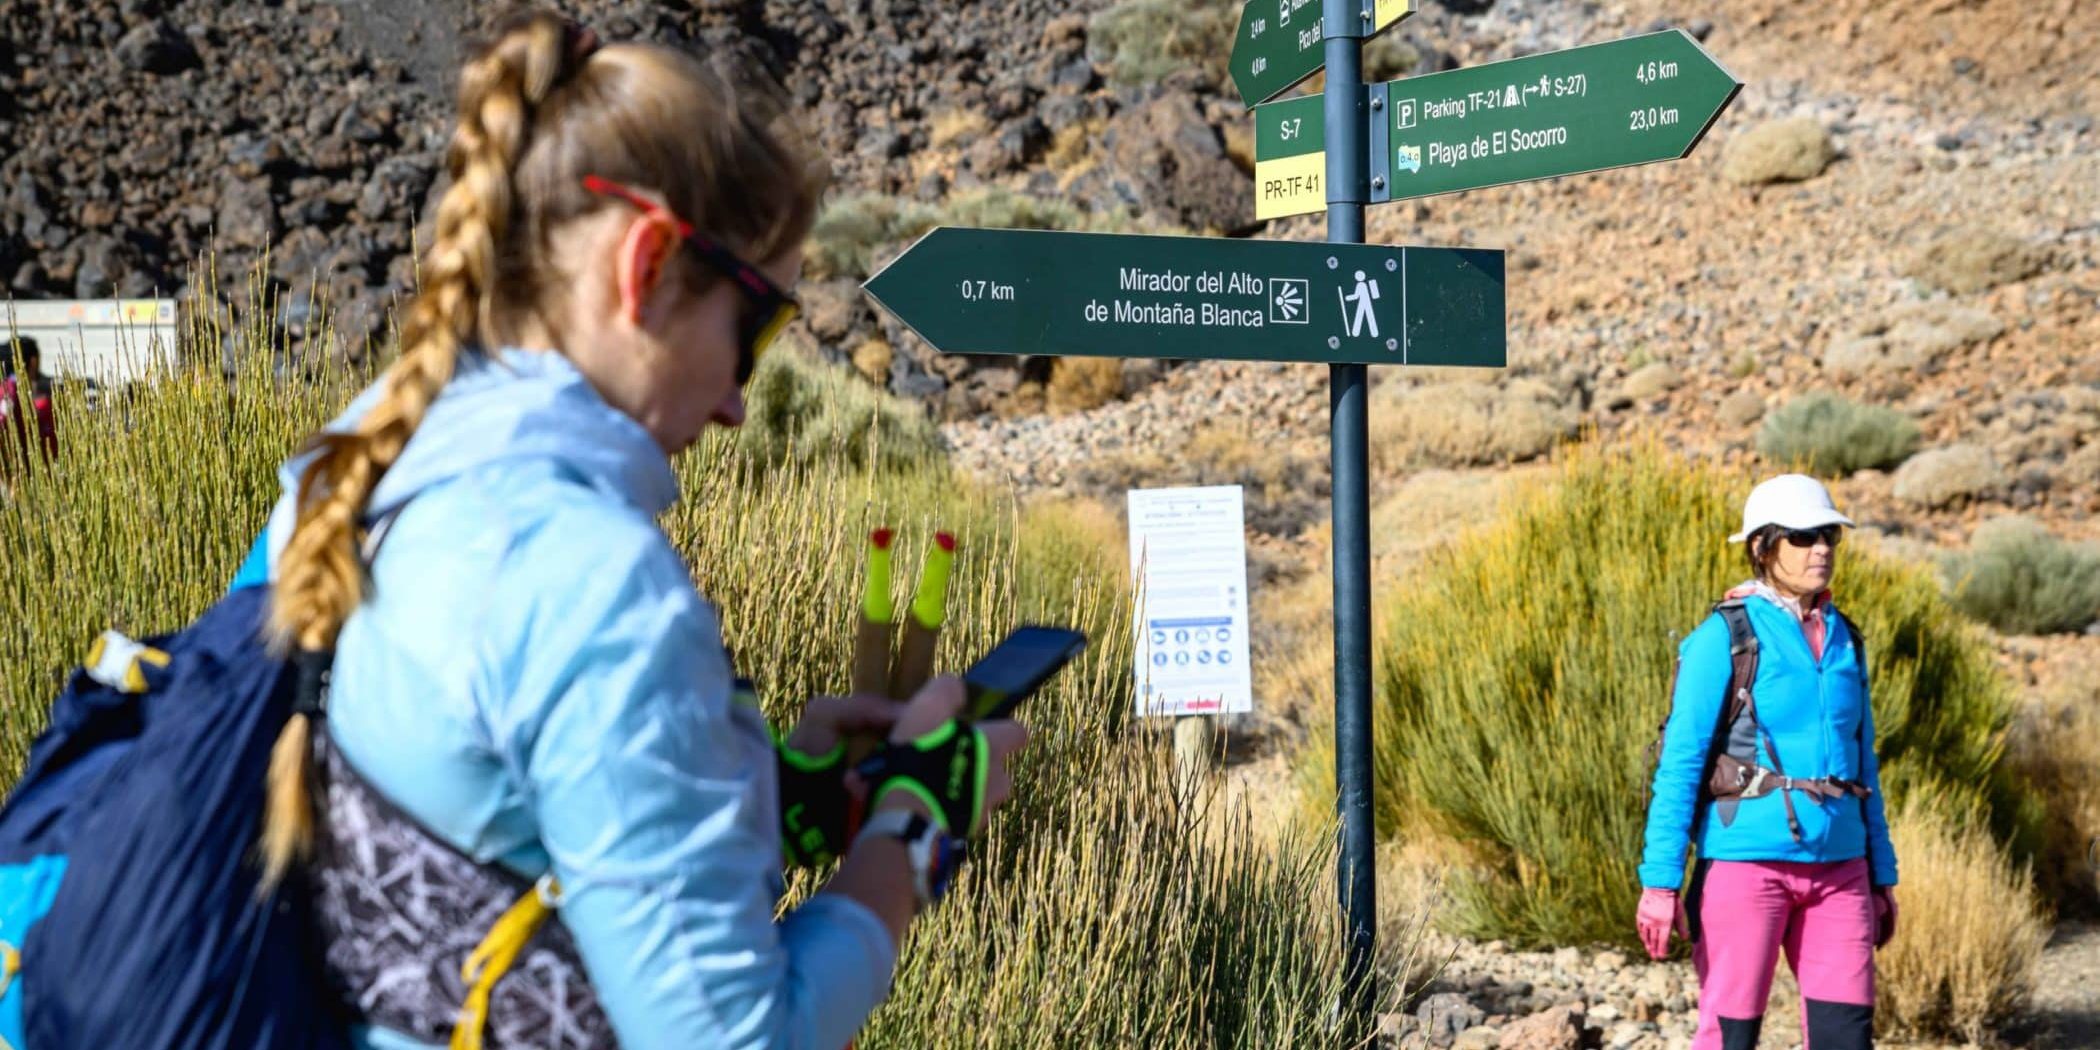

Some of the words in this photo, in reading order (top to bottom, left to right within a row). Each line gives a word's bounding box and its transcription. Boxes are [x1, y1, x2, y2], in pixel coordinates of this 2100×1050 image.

[1299, 30, 1311, 52] Pico
[1312, 20, 1320, 44] del
[1636, 61, 1656, 85] 4,6
[1659, 60, 1678, 80] km
[1424, 97, 1466, 120] Parking
[1468, 89, 1500, 112] TF-21
[1280, 118, 1301, 140] S-7
[1630, 107, 1657, 131] 23,0
[1660, 106, 1679, 125] km
[1429, 141, 1468, 168] Playa
[1471, 135, 1489, 159] de
[1492, 130, 1506, 155] El
[1511, 126, 1567, 152] Socorro
[1265, 177, 1302, 200] PR-TF
[1305, 173, 1319, 193] 41
[962, 280, 986, 302] 0,7
[991, 280, 1015, 300] km
[1120, 267, 1191, 292] Mirador
[1196, 270, 1223, 293] del
[1227, 271, 1263, 295] Alto
[1084, 299, 1109, 322] de
[1114, 299, 1195, 325] Montaña
[1201, 302, 1263, 327] Blanca
